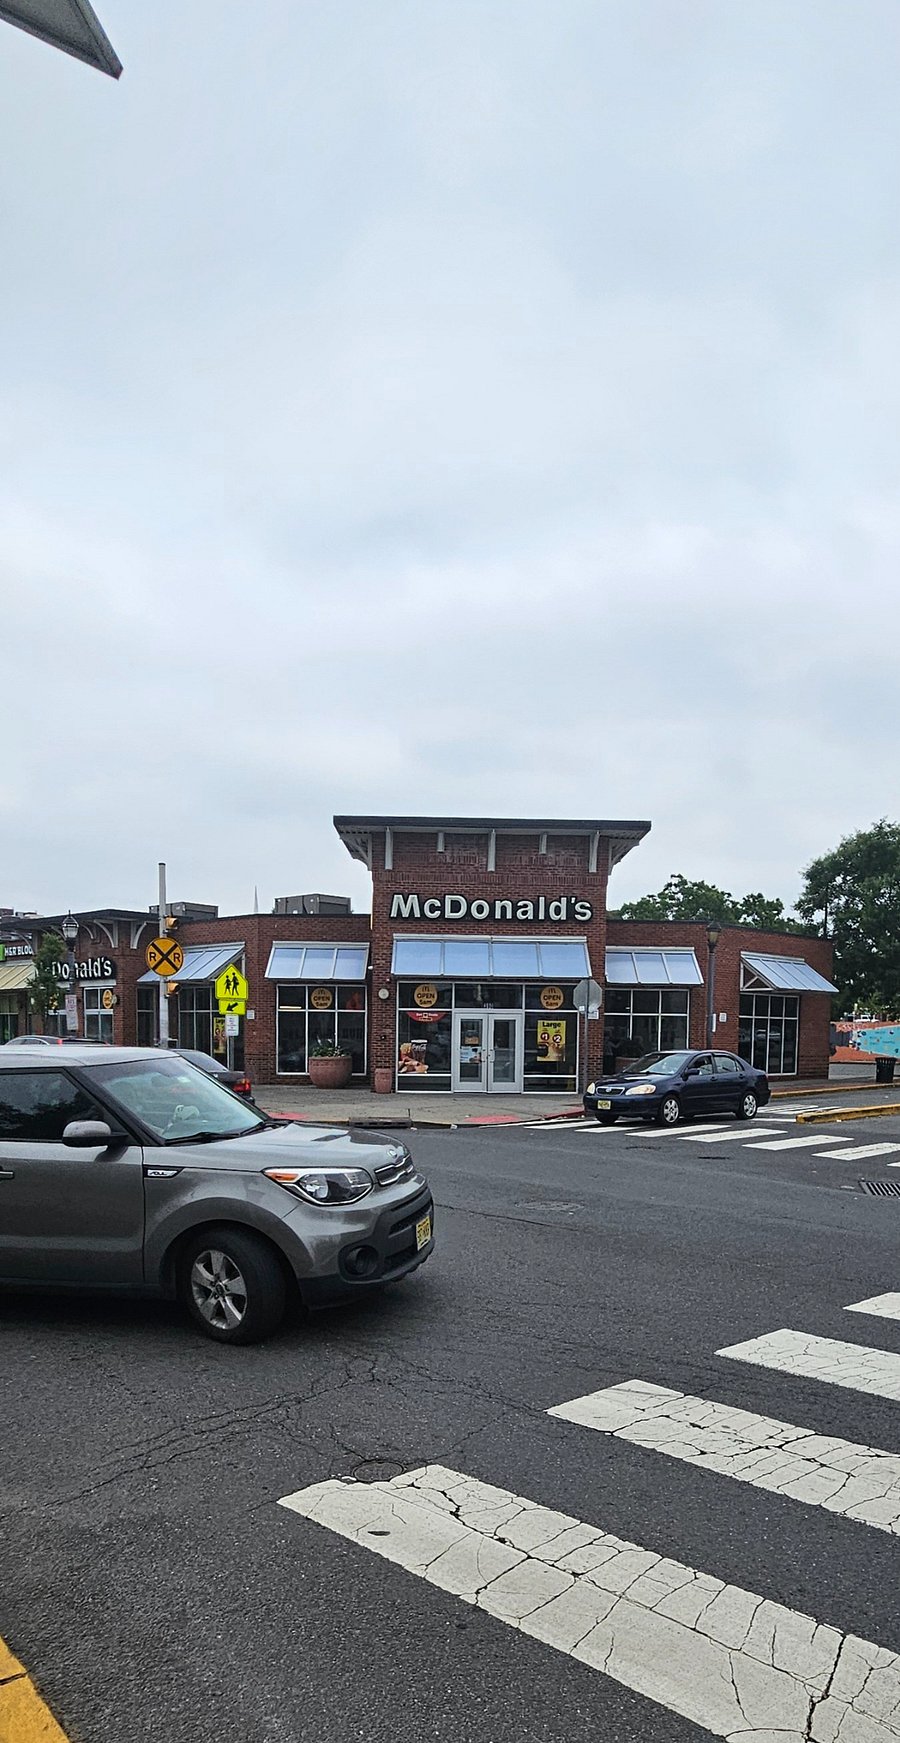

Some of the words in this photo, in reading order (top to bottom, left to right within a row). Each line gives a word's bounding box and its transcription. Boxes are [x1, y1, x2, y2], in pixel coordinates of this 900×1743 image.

[390, 894, 592, 921] McDonald's
[18, 945, 33, 955] BLOC
[149, 951, 157, 962] R
[173, 952, 181, 963] R
